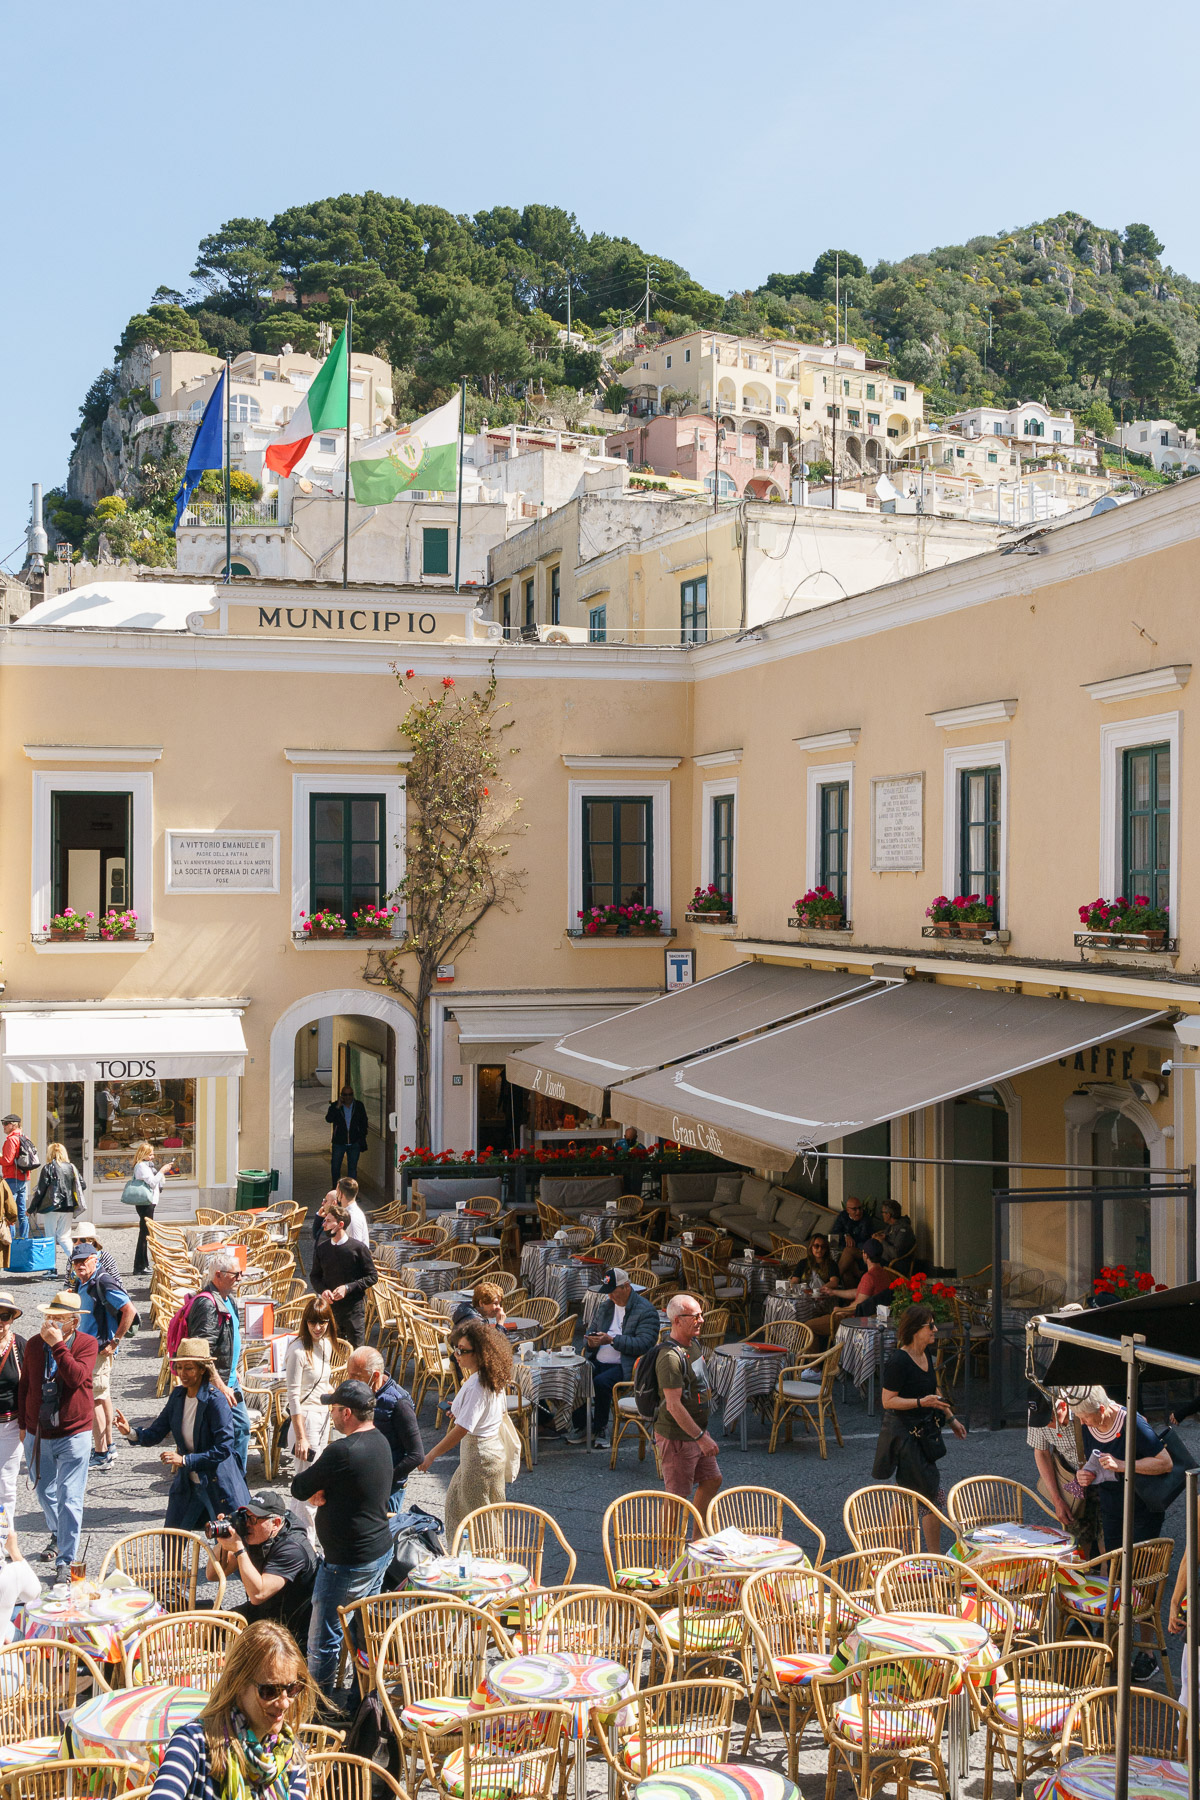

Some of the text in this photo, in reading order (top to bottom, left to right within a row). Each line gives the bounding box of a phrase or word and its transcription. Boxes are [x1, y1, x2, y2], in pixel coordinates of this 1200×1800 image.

[258, 607, 436, 634] MUNICIPIO
[670, 959, 688, 982] T
[96, 1060, 156, 1078] TOD'S
[672, 1116, 697, 1147] Gran
